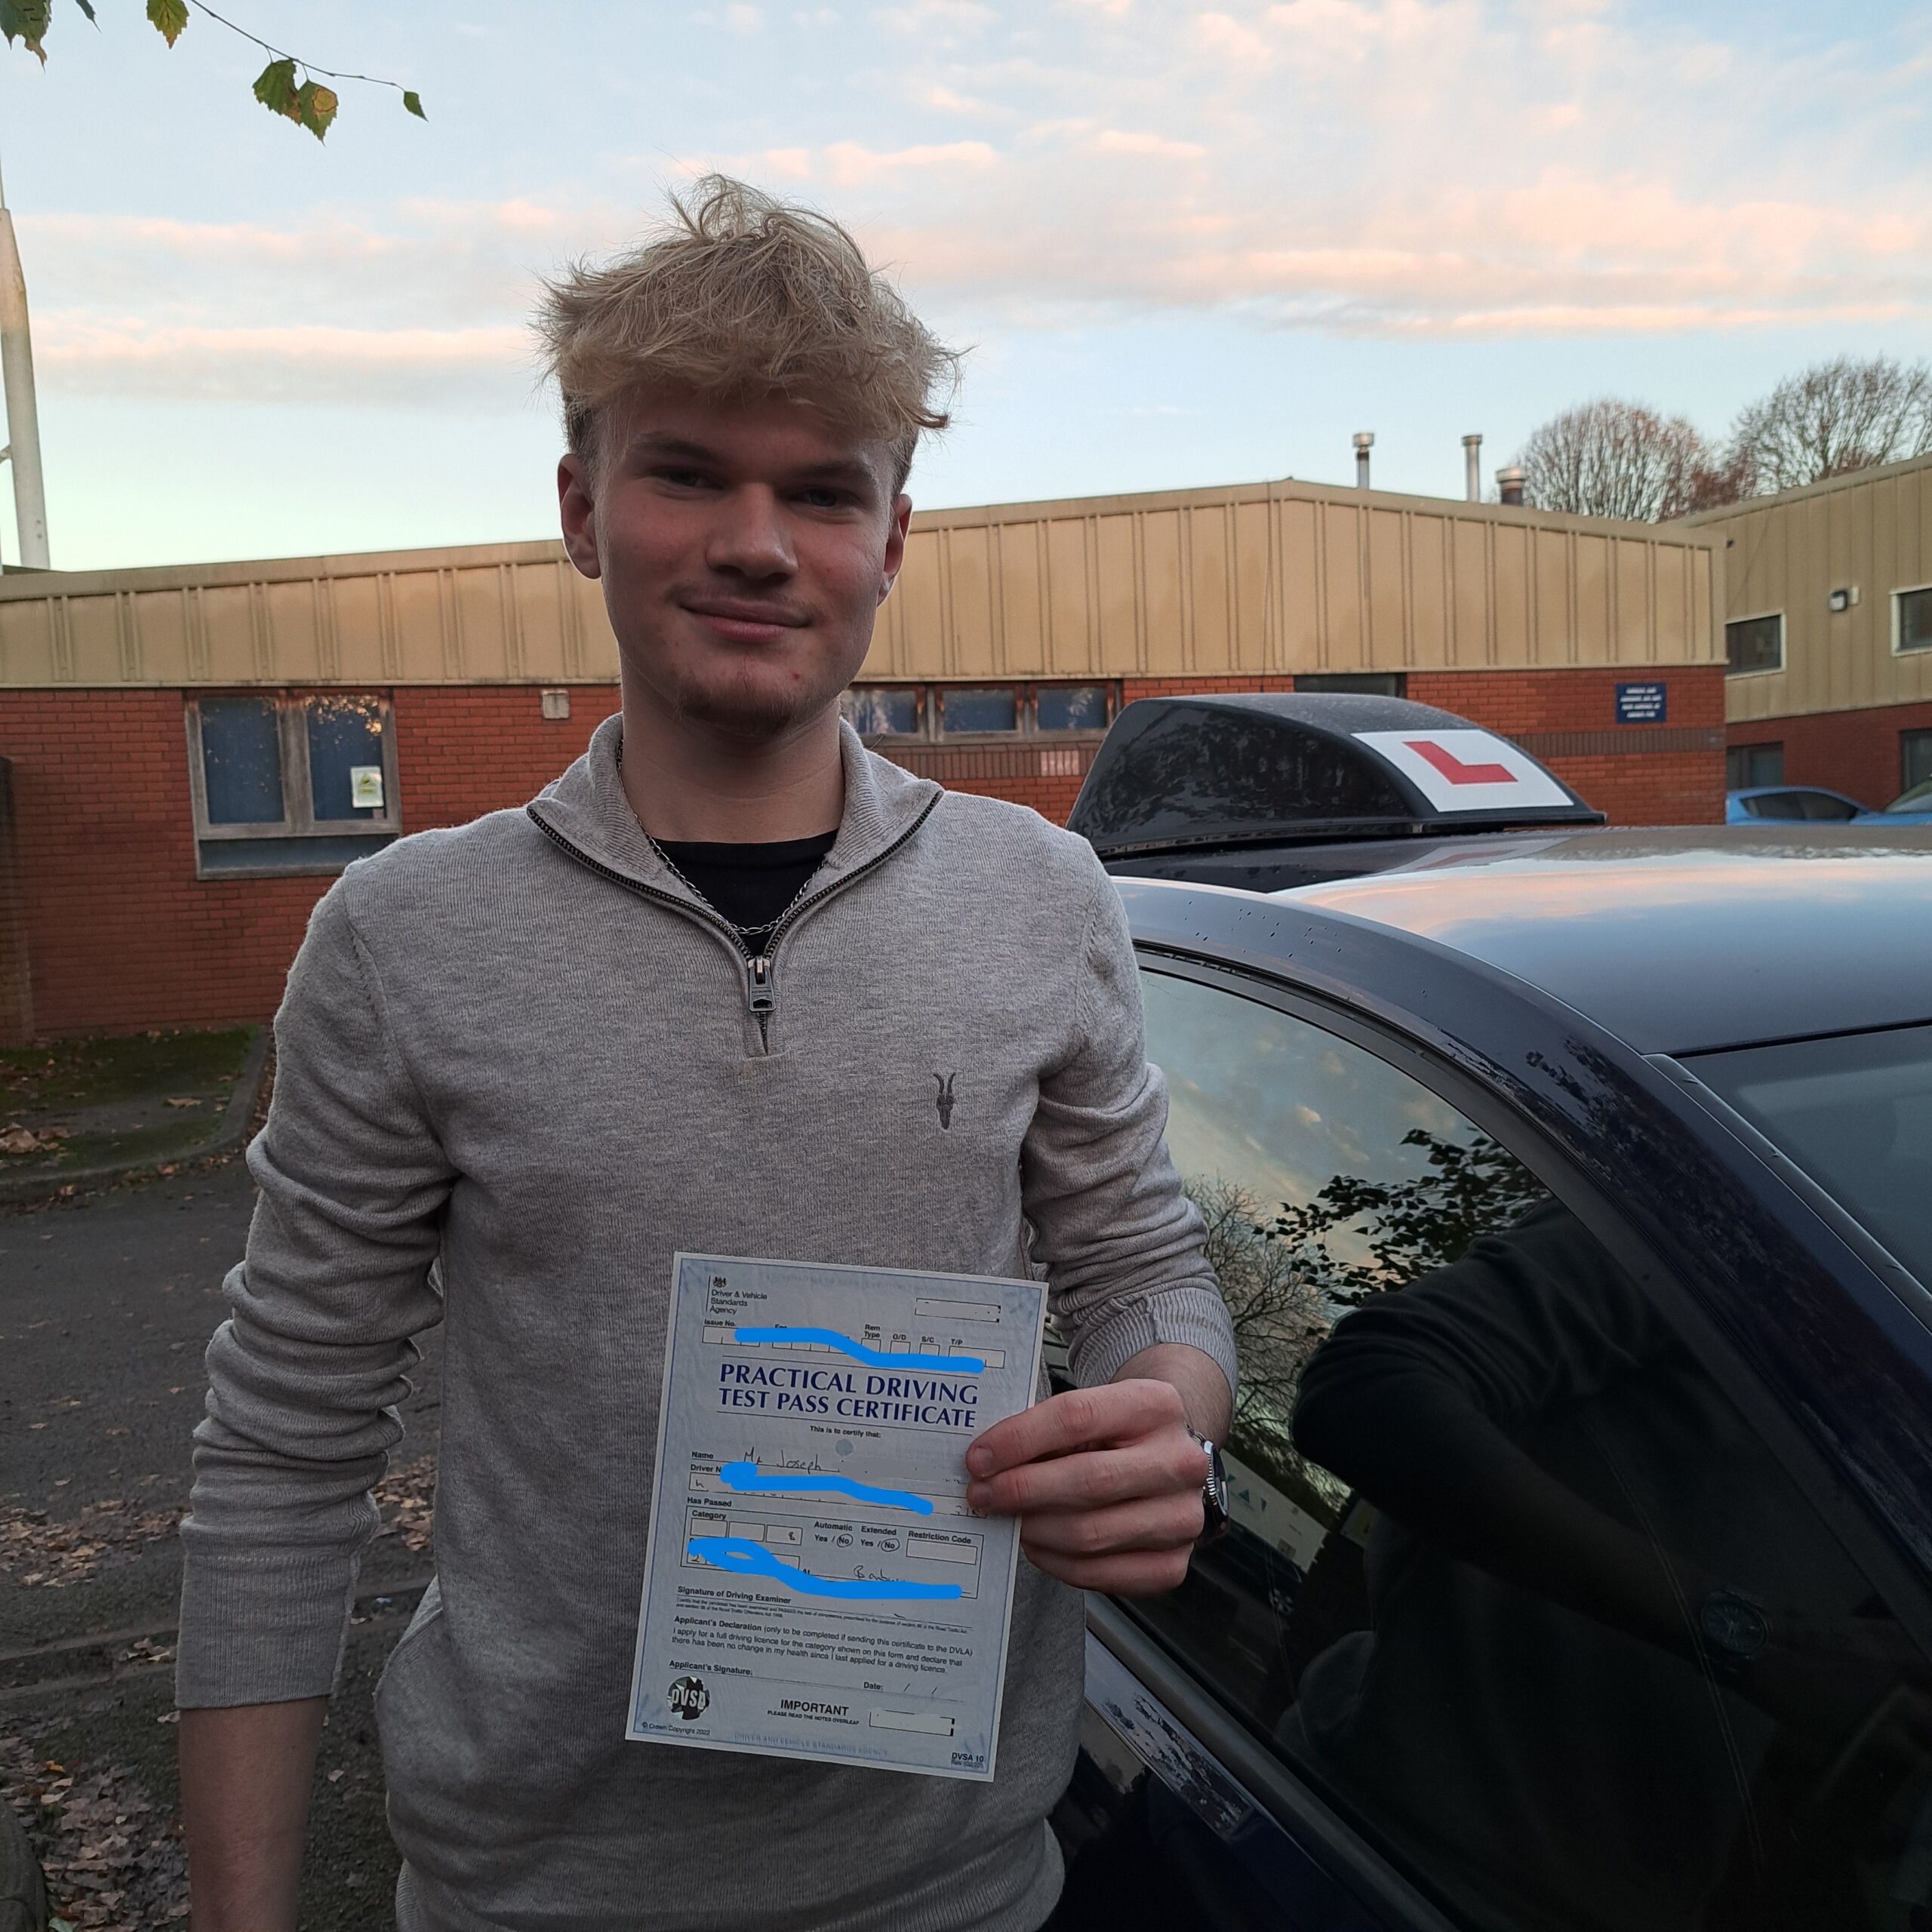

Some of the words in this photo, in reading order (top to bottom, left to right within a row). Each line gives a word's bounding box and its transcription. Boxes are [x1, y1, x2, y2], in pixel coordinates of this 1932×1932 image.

[1402, 740, 1518, 785] L
[711, 1288, 734, 1297] Driver
[741, 1291, 768, 1300] Vehicle
[711, 1297, 748, 1307] Standards
[709, 1306, 737, 1315] Agency
[703, 1318, 724, 1326] Issue
[864, 1331, 881, 1340] Type
[892, 1333, 907, 1341] O/D
[720, 1363, 857, 1394] PRACTICAL
[866, 1375, 978, 1405] DRIVING
[718, 1387, 771, 1409] TEST
[777, 1392, 829, 1414] PASS
[836, 1398, 977, 1428] CERTIFICATE
[809, 1425, 825, 1433] This
[841, 1429, 865, 1438] certify
[691, 1451, 714, 1460] Name
[690, 1463, 714, 1473] Driver
[776, 1450, 822, 1475] Joseph
[687, 1496, 702, 1505] Has
[703, 1497, 733, 1507] Passed
[692, 1510, 726, 1520] Category
[813, 1521, 853, 1532] Automatic
[860, 1525, 897, 1536] Extended
[814, 1534, 829, 1543] Yes
[838, 1536, 850, 1545] No
[908, 1530, 950, 1542] Restriction
[951, 1535, 972, 1544] Code
[860, 1539, 874, 1547] Yes
[884, 1540, 895, 1549] No
[677, 1586, 715, 1597] Signature
[725, 1590, 754, 1602] Driving
[755, 1593, 792, 1604] Examiner
[673, 1615, 717, 1627] Applicant's
[718, 1620, 762, 1632] Declaration
[764, 1625, 782, 1635] (only
[791, 1627, 801, 1636] be
[802, 1630, 840, 1640] completed
[841, 1633, 846, 1641] if
[847, 1635, 875, 1646] sending
[876, 1638, 890, 1646] this
[891, 1641, 926, 1651] certificate
[936, 1644, 947, 1653] the
[949, 1646, 974, 1657] DVLA)
[672, 1635, 691, 1644] there
[691, 1638, 706, 1647] has
[706, 1639, 725, 1649] been
[737, 1643, 764, 1654] change
[765, 1646, 773, 1654] in
[774, 1647, 786, 1657] my
[786, 1647, 809, 1658] health
[810, 1652, 829, 1660] since
[831, 1652, 834, 1660] I
[835, 1654, 848, 1663] last
[849, 1657, 876, 1666] applied
[877, 1658, 887, 1667] for
[894, 1661, 919, 1672] driving
[677, 1629, 697, 1638] apply
[698, 1629, 709, 1638] for
[716, 1631, 728, 1639] full
[728, 1632, 752, 1644] driving
[753, 1635, 779, 1645] licence
[780, 1638, 791, 1646] for
[792, 1640, 804, 1648] the
[804, 1642, 837, 1654] category
[837, 1645, 861, 1655] shown
[873, 1649, 886, 1657] this
[888, 1651, 904, 1660] form
[905, 1654, 920, 1662] and
[920, 1655, 948, 1665] declare
[949, 1658, 963, 1667] that
[669, 1660, 711, 1671] Applicant's
[672, 1688, 706, 1710] DVSA
[780, 1698, 850, 1717] IMPORTANT
[832, 1717, 860, 1725] OVERLEAF
[668, 1723, 696, 1735] Copyright
[696, 1728, 711, 1737] 2022
[951, 1752, 974, 1761] DVSA
[976, 1755, 984, 1763] 10
